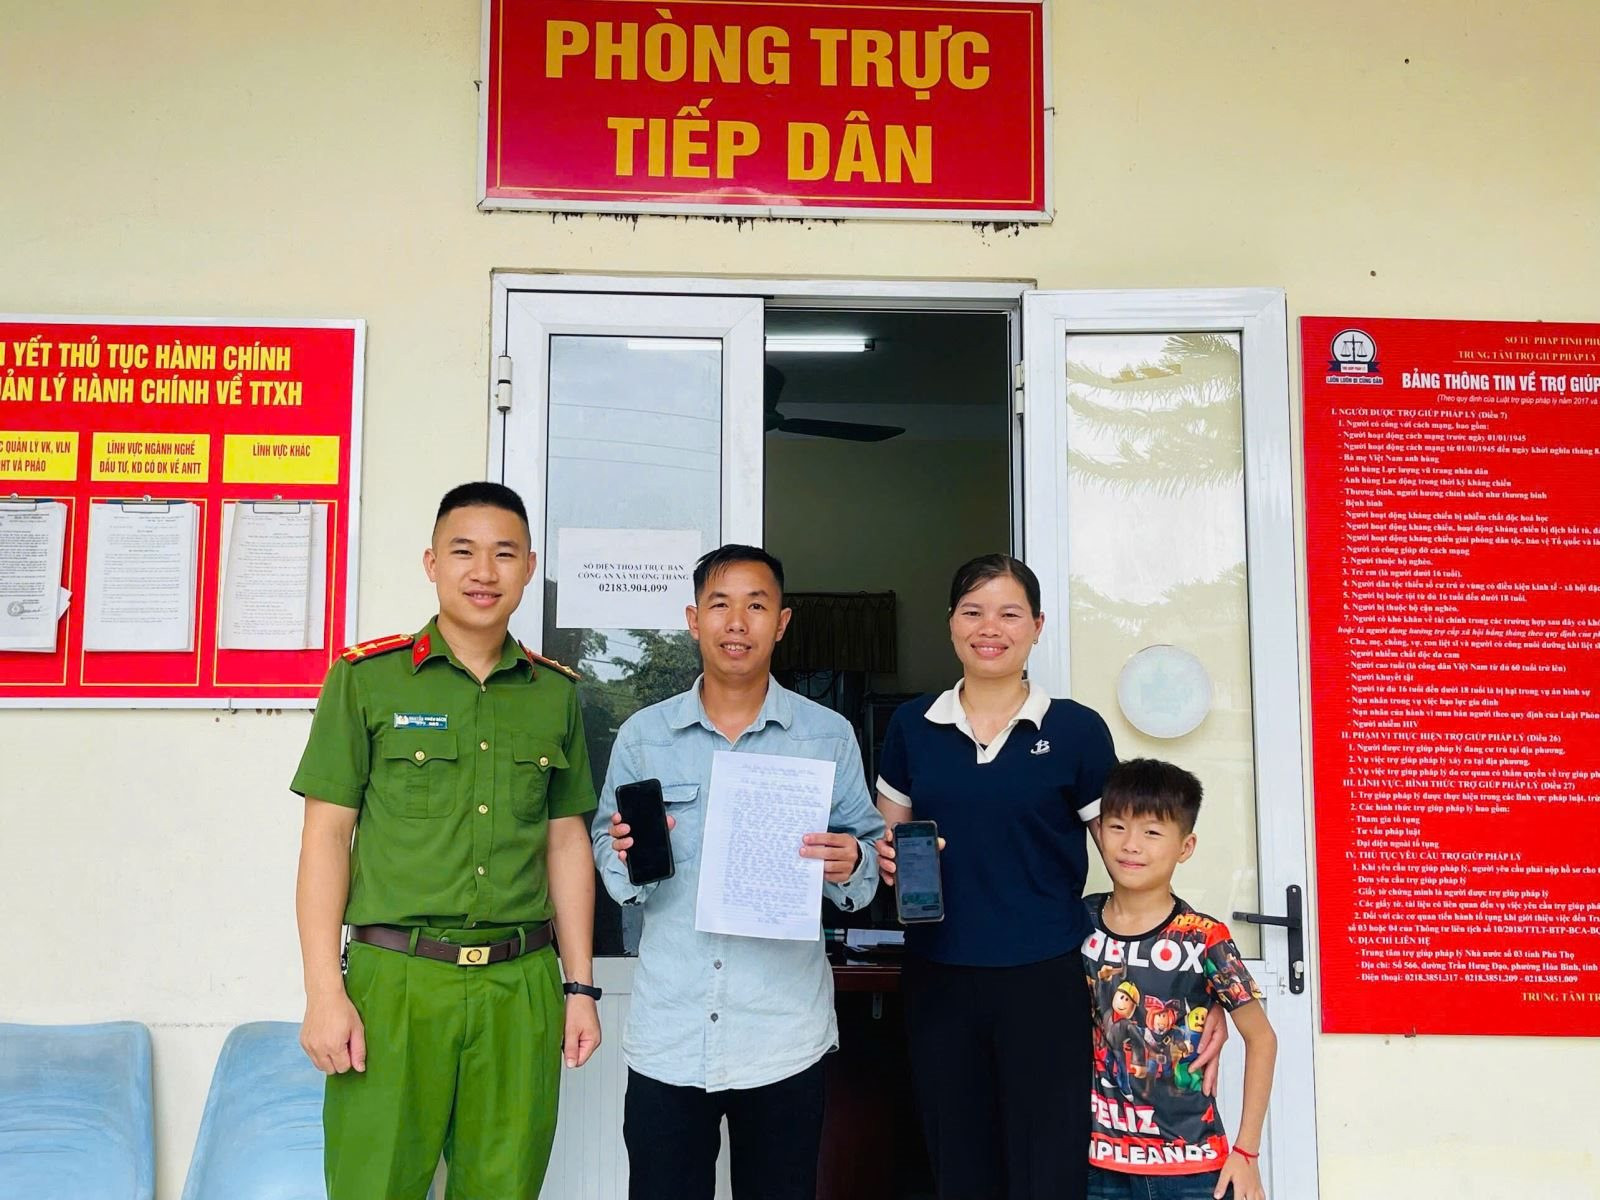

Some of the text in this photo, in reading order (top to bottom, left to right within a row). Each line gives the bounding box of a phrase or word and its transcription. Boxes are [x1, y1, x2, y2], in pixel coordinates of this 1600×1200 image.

[546, 9, 990, 99] PHÒNG TRỰC
[607, 98, 932, 184] TIẾP DÂN
[13, 335, 52, 367] YẾT
[58, 335, 100, 368] THỦ
[107, 344, 149, 374] TỤC
[155, 340, 216, 370] HÀNH
[223, 341, 291, 371] CHÍNH
[0, 368, 303, 406] ẢN LÝ HÀNH CHÍNH VỀ TTXH
[1401, 369, 1600, 394] BẢNG THÔNG TIN VỀ TRỢ GIÚP
[56, 441, 71, 454] VLN
[107, 440, 126, 454] LĨNH
[128, 441, 142, 457] VỰC
[144, 441, 172, 455] NGÀNH
[272, 444, 288, 460] VỰC
[290, 443, 310, 457] KHÁC
[132, 461, 142, 473] KD
[144, 459, 155, 474] CÓ
[182, 462, 202, 475] ANTT
[598, 583, 668, 592] 02183.904.099
